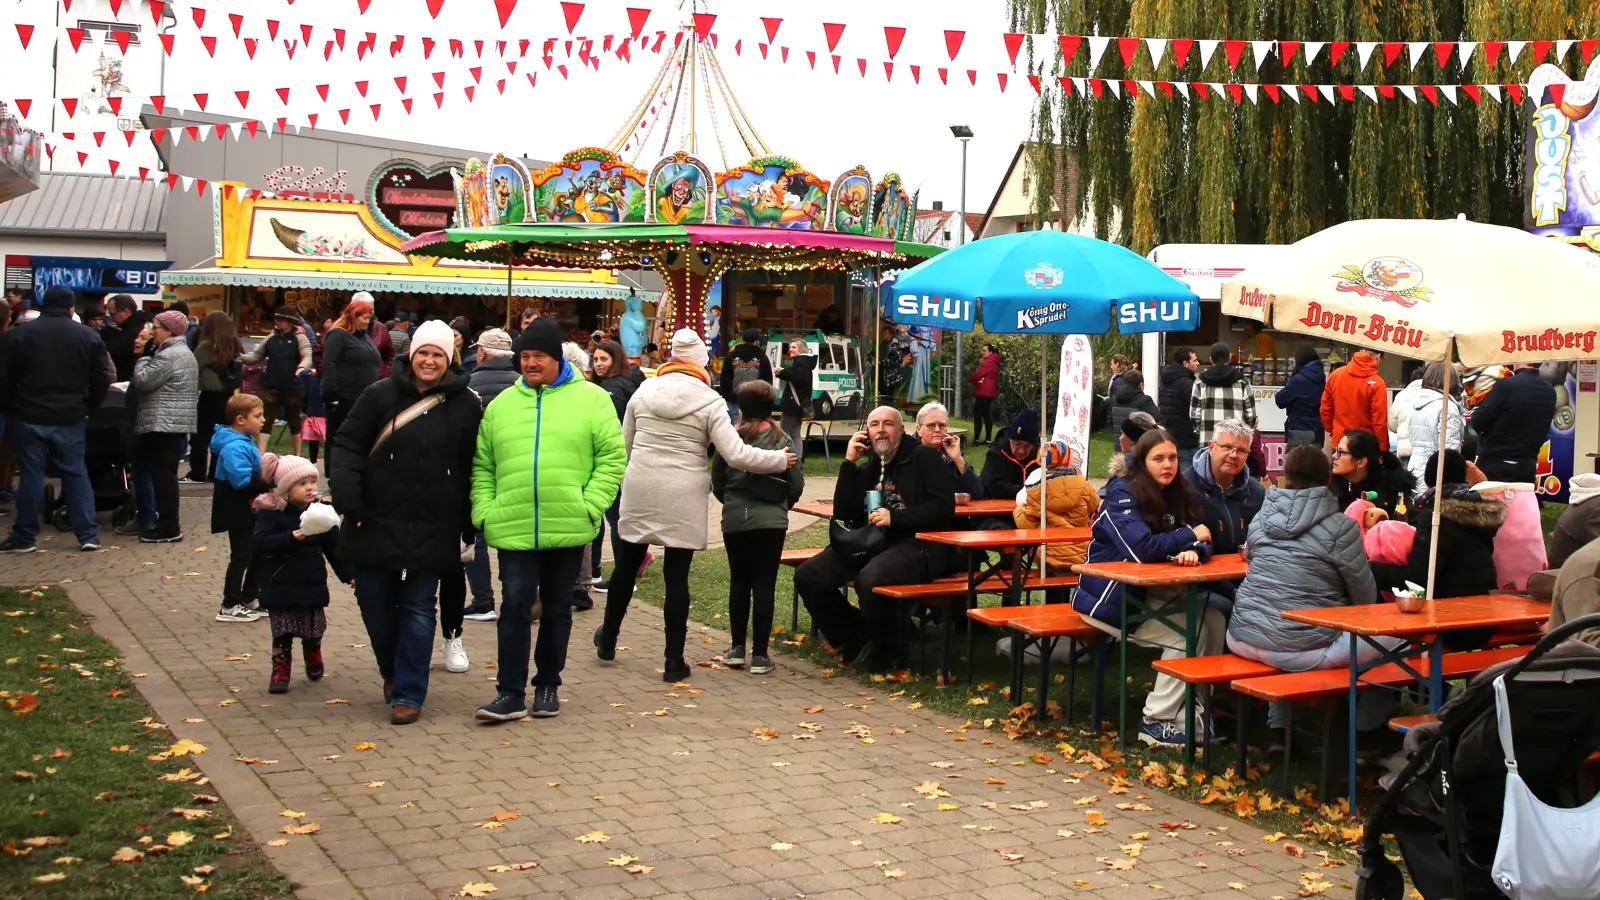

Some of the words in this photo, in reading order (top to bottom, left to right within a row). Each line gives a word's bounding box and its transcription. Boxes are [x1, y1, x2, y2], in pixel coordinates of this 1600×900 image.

[259, 277, 309, 286] Makronen
[347, 281, 389, 289] Mandeln
[424, 284, 463, 292] Popcorn
[473, 286, 541, 295] Schokorüchte
[552, 288, 599, 296] Magenbrot
[606, 289, 647, 299] Makren
[1017, 306, 1049, 329] König
[1033, 310, 1067, 326] Sprudel
[1300, 301, 1423, 348] Dorn-Bräu
